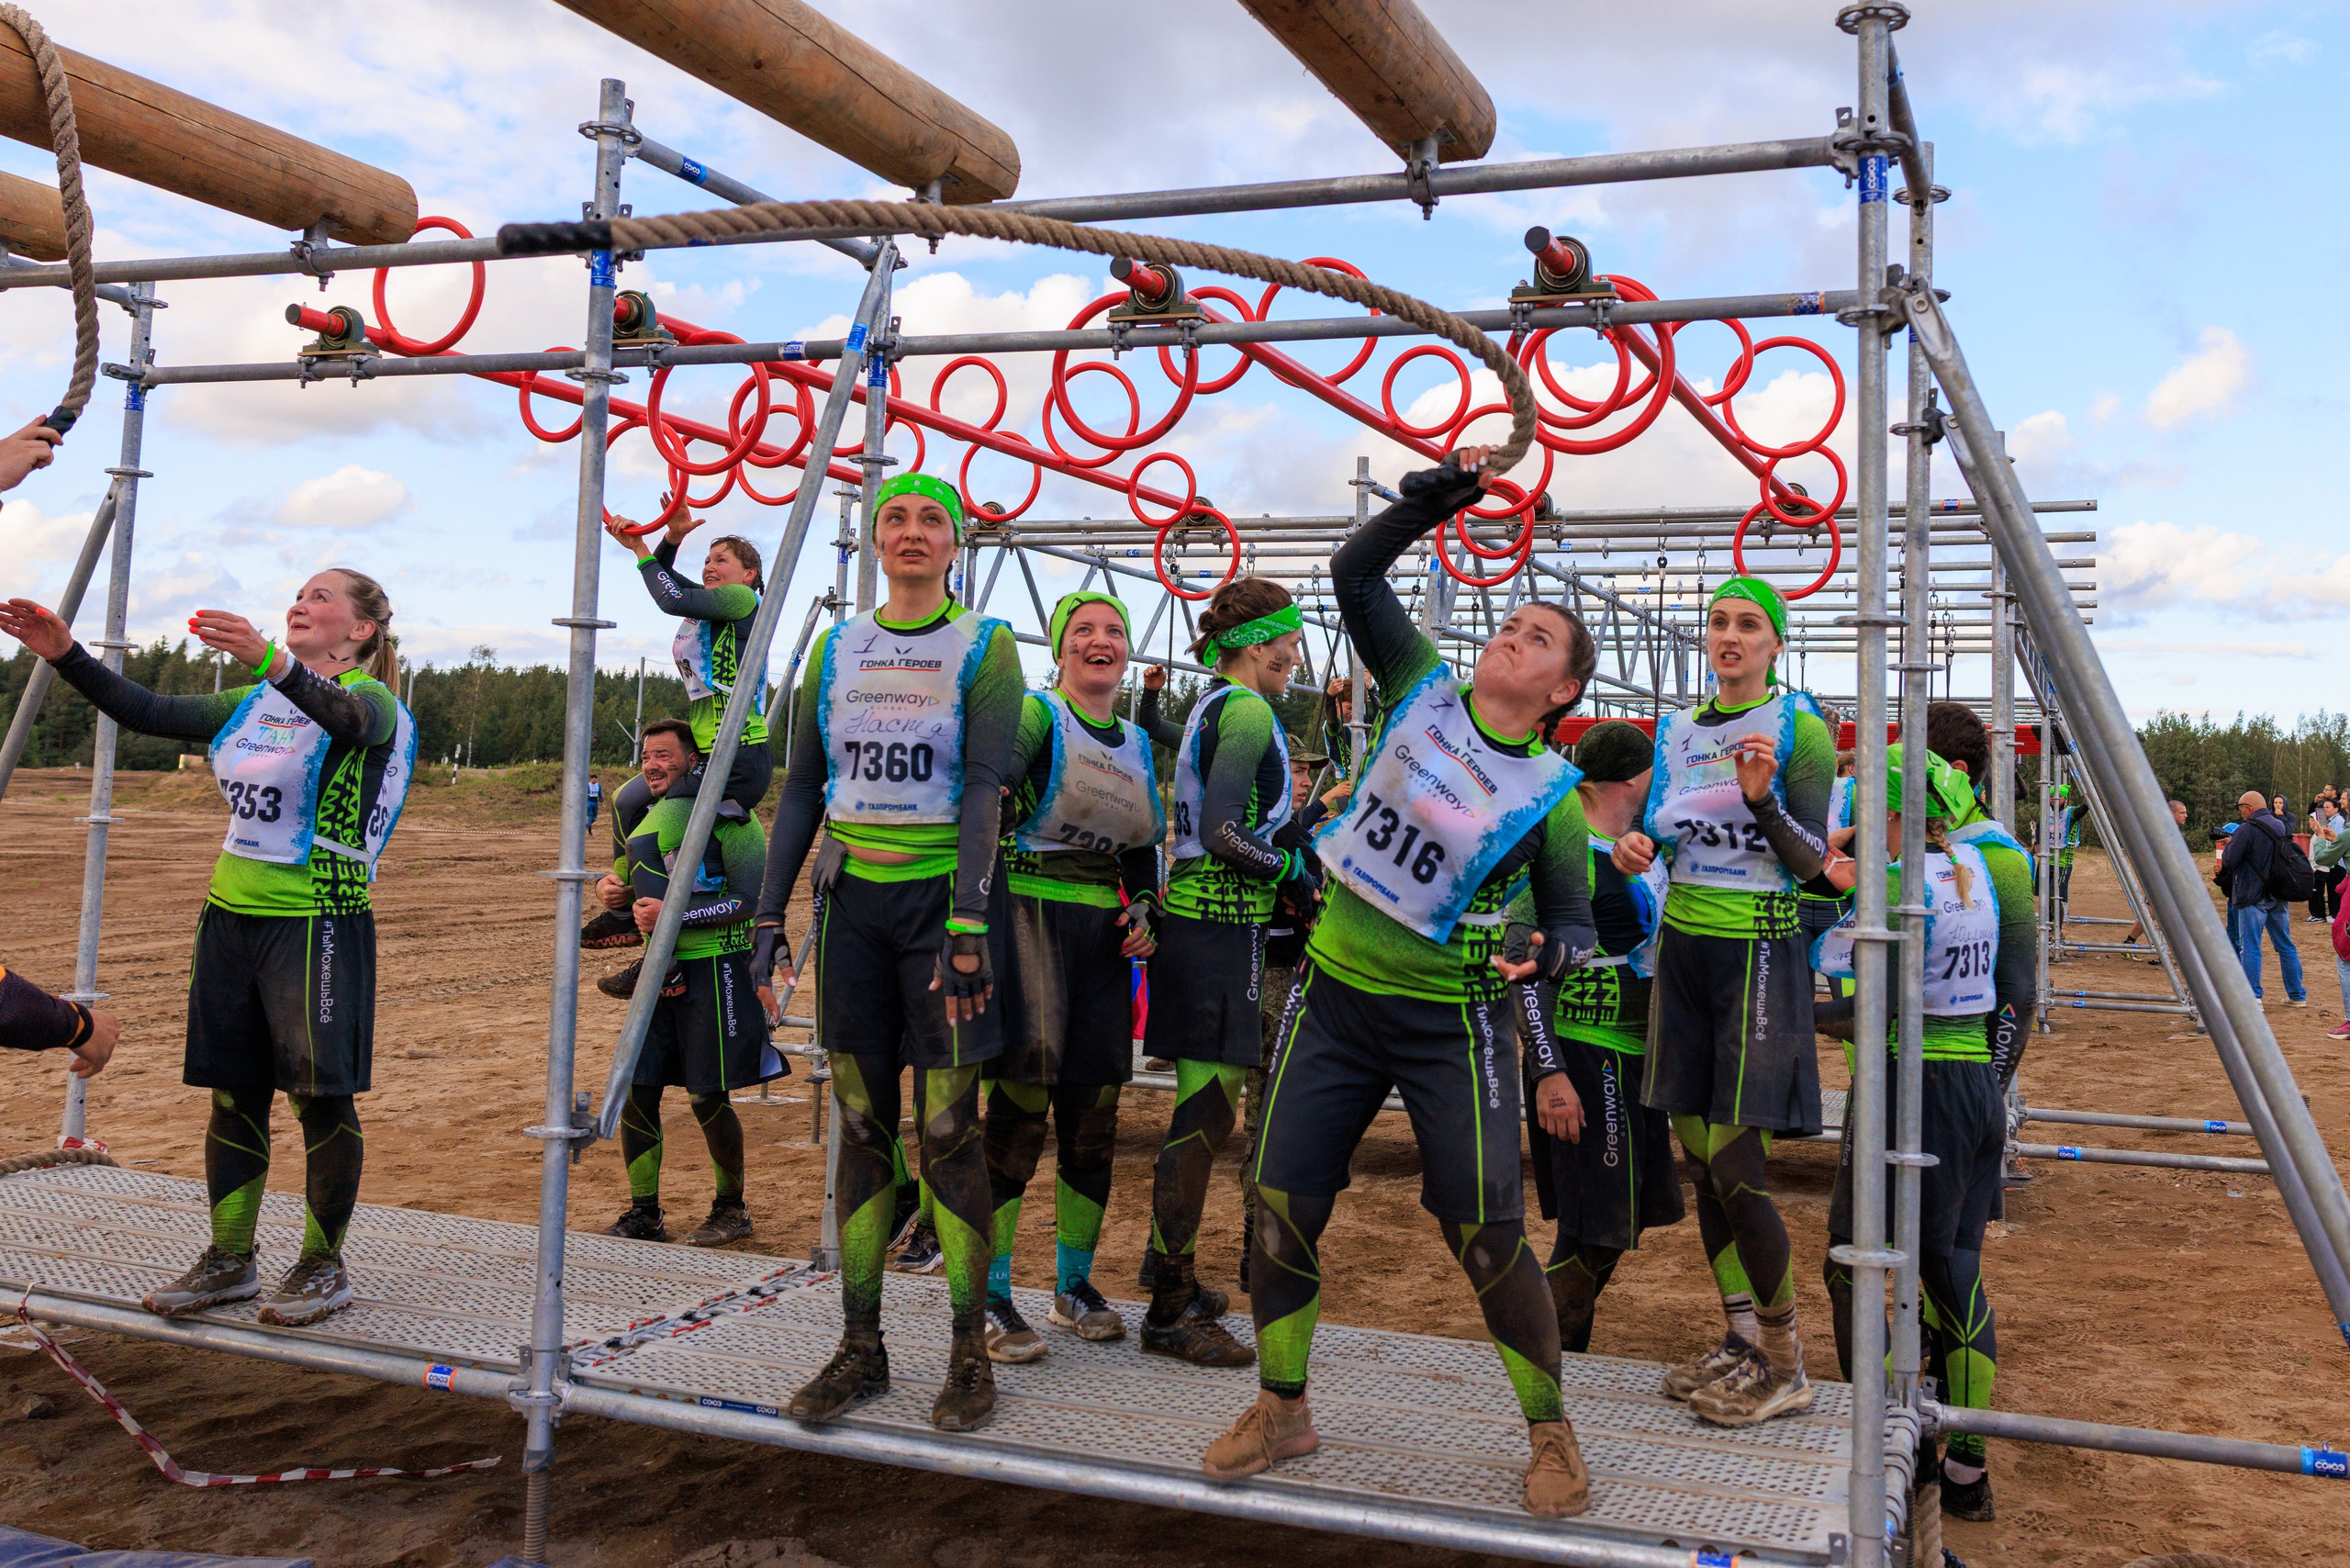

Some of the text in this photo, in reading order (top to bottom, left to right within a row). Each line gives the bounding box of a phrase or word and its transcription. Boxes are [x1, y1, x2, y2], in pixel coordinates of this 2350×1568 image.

[859, 658, 943, 668] ГОНКА ГЕРОЕВ
[845, 689, 929, 708] Greenway
[260, 713, 285, 725] ГОНКА
[236, 738, 286, 756] Greenway
[844, 741, 934, 783] 7360
[1079, 753, 1105, 770] ГОНКА
[1427, 723, 1499, 795] ГОНКА ГЕРОЕВ
[1686, 742, 1747, 766] ГОНКА ГЕРОЕ
[1394, 745, 1468, 811] Greenway
[1408, 773, 1442, 803] GLOBAL
[1679, 778, 1740, 796] Greenwa
[867, 802, 918, 812] ГАЗПРОМБАНК
[1075, 779, 1136, 812] Greenway
[1222, 820, 1280, 868] Greenway
[1352, 791, 1446, 885] 7316
[1673, 818, 1767, 854] 7312
[1353, 867, 1401, 904] ГАЗПРОМБАНК
[1701, 865, 1747, 876] ГАЗПРОМБАНК
[683, 902, 733, 921] eenway
[319, 920, 334, 1024] #ТыМожешьВсё
[1247, 923, 1261, 1001] Greenway
[1942, 941, 1990, 980] 7313
[722, 962, 737, 1037] #ТыМожешьВсё
[1755, 941, 1771, 1041] #ТыМожешьВсё
[1959, 992, 1984, 1002] ГАЗПРОМБАНК
[1476, 1002, 1501, 1109] ТыМожешьВсё
[1603, 1072, 1618, 1167] Greenway
[701, 1397, 722, 1407] СОЮЗ
[755, 1406, 777, 1415] СОЮЗ
[2314, 1461, 2346, 1473] СОЮЗ
